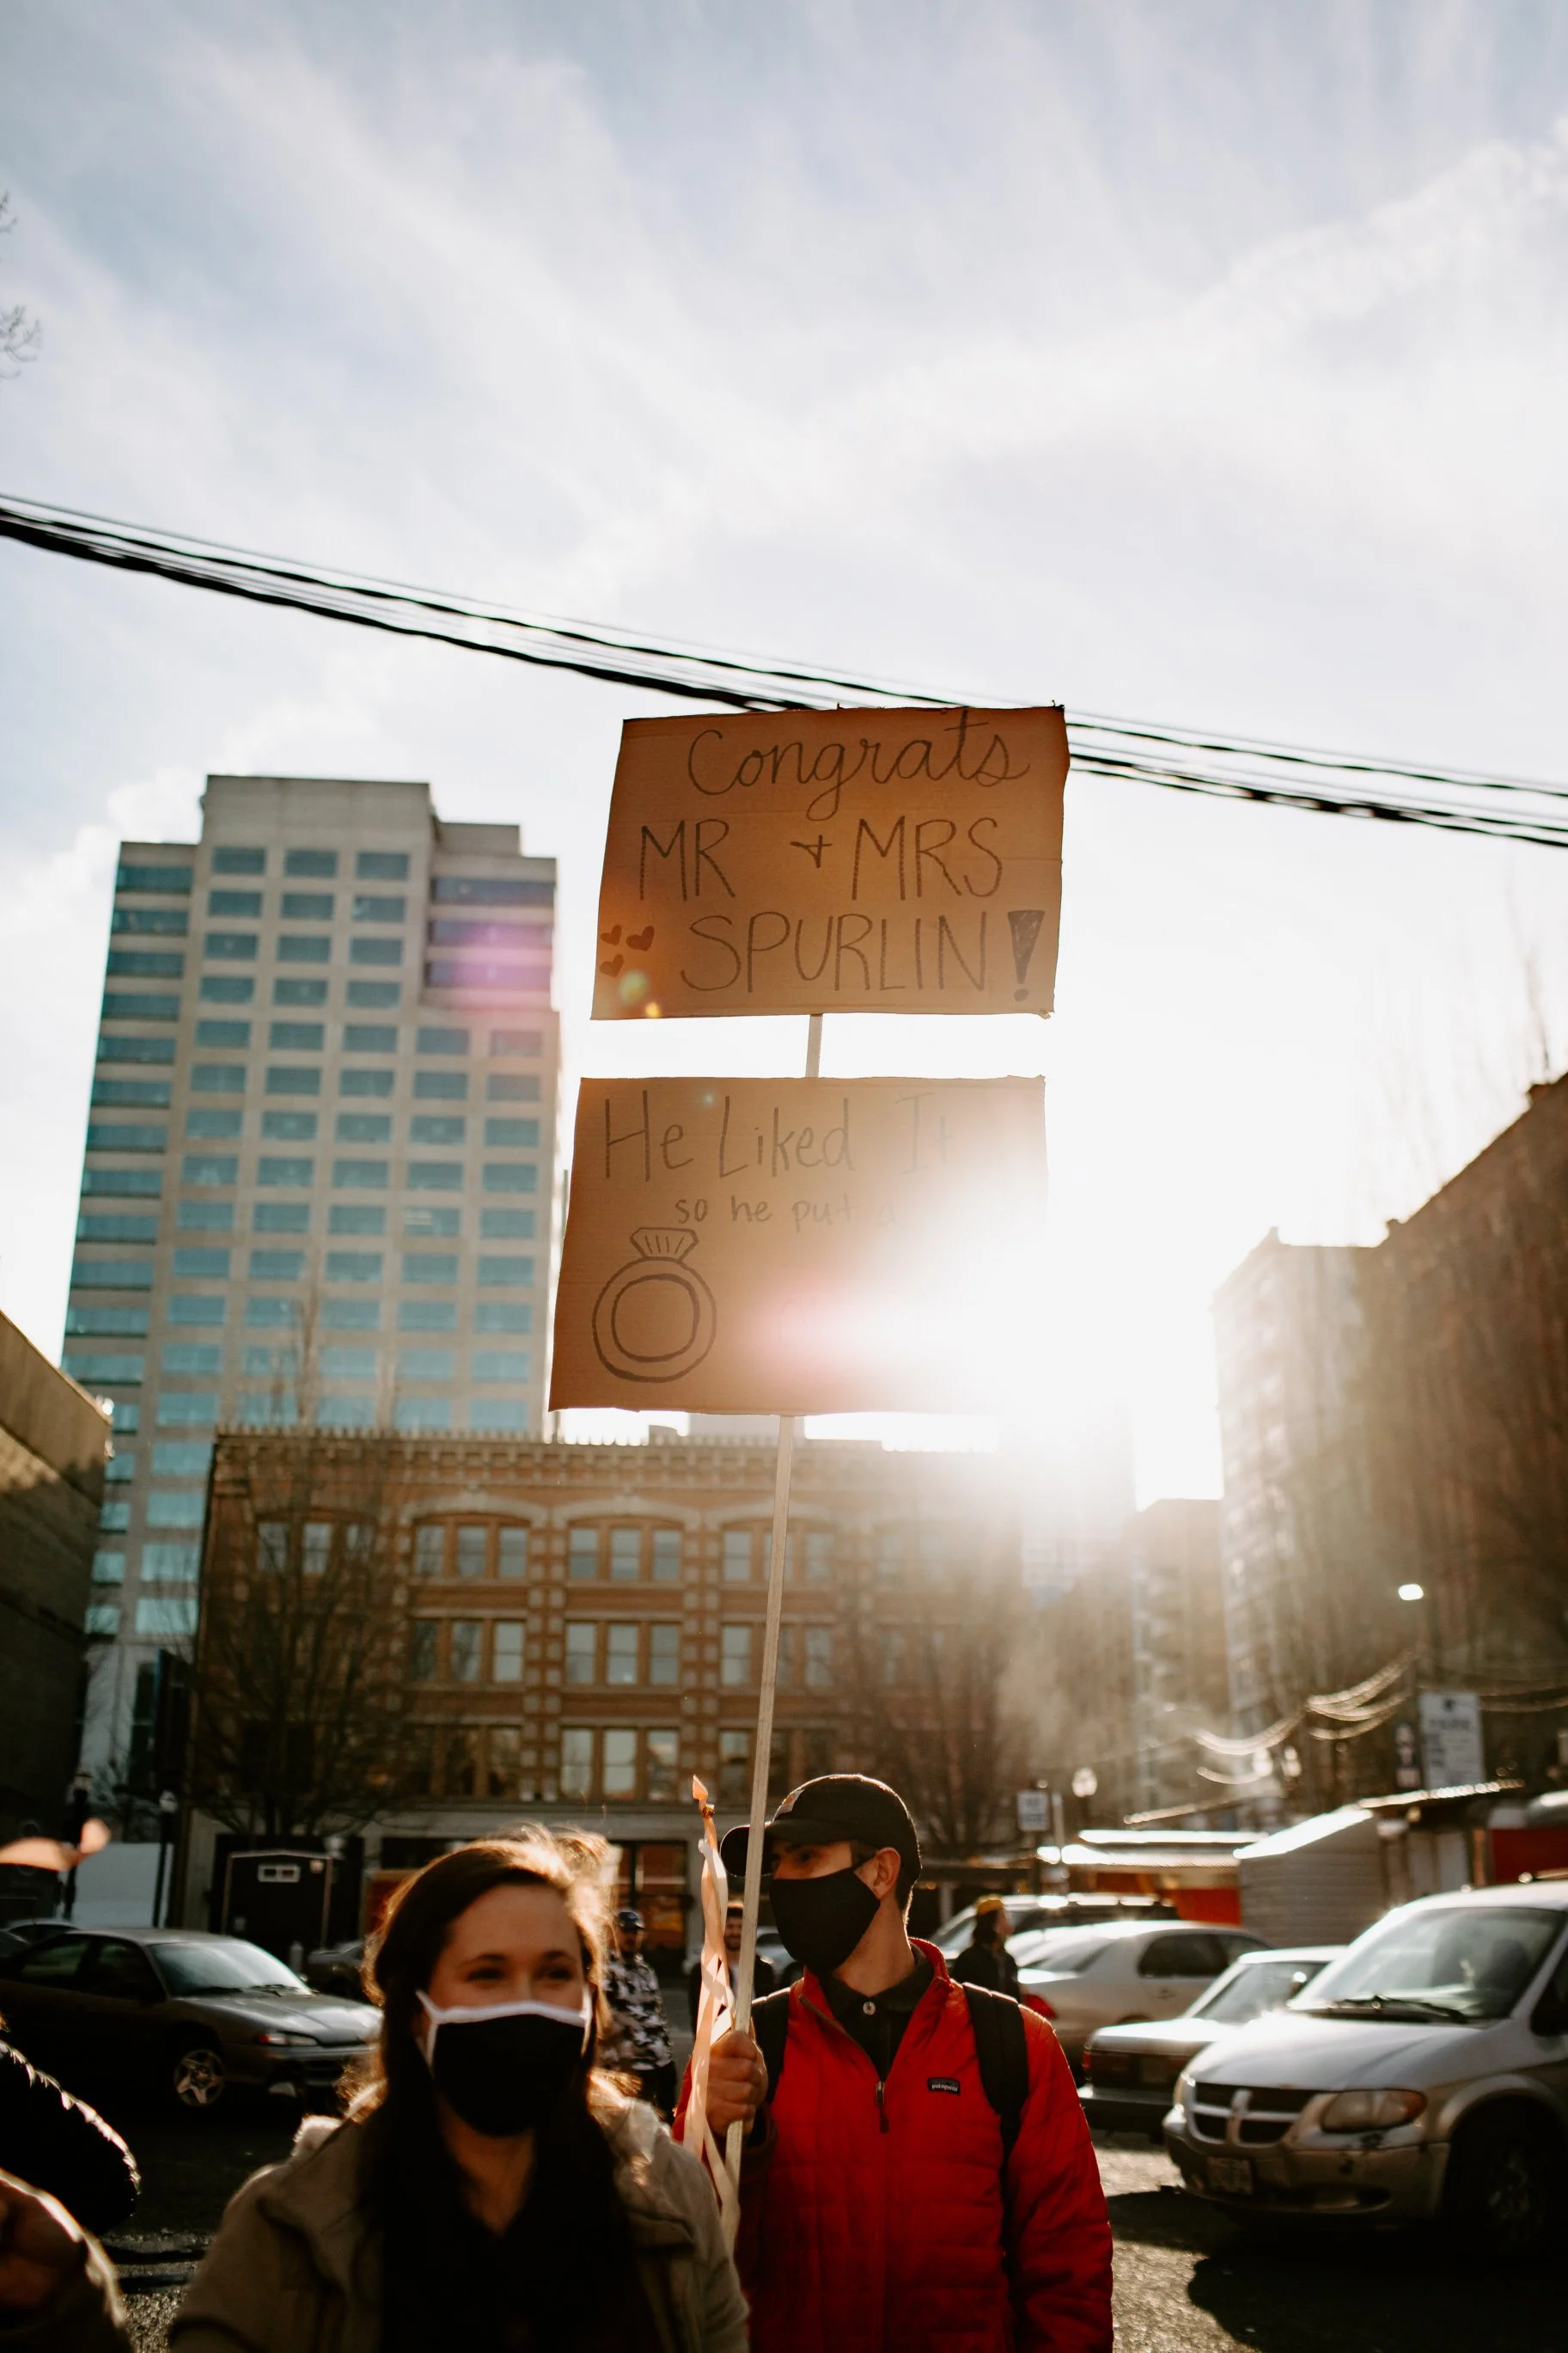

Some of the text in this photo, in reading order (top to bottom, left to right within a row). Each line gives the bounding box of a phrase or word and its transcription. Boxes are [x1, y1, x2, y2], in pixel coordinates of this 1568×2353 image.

[688, 709, 1030, 821] Congrats
[640, 816, 1003, 901] MR + MRS
[680, 910, 1046, 1003] SPURLIN!
[605, 1090, 694, 1182] He
[718, 1096, 855, 1178] Liked
[675, 1197, 709, 1225] so
[730, 1194, 772, 1224] he
[791, 1193, 857, 1232] put
